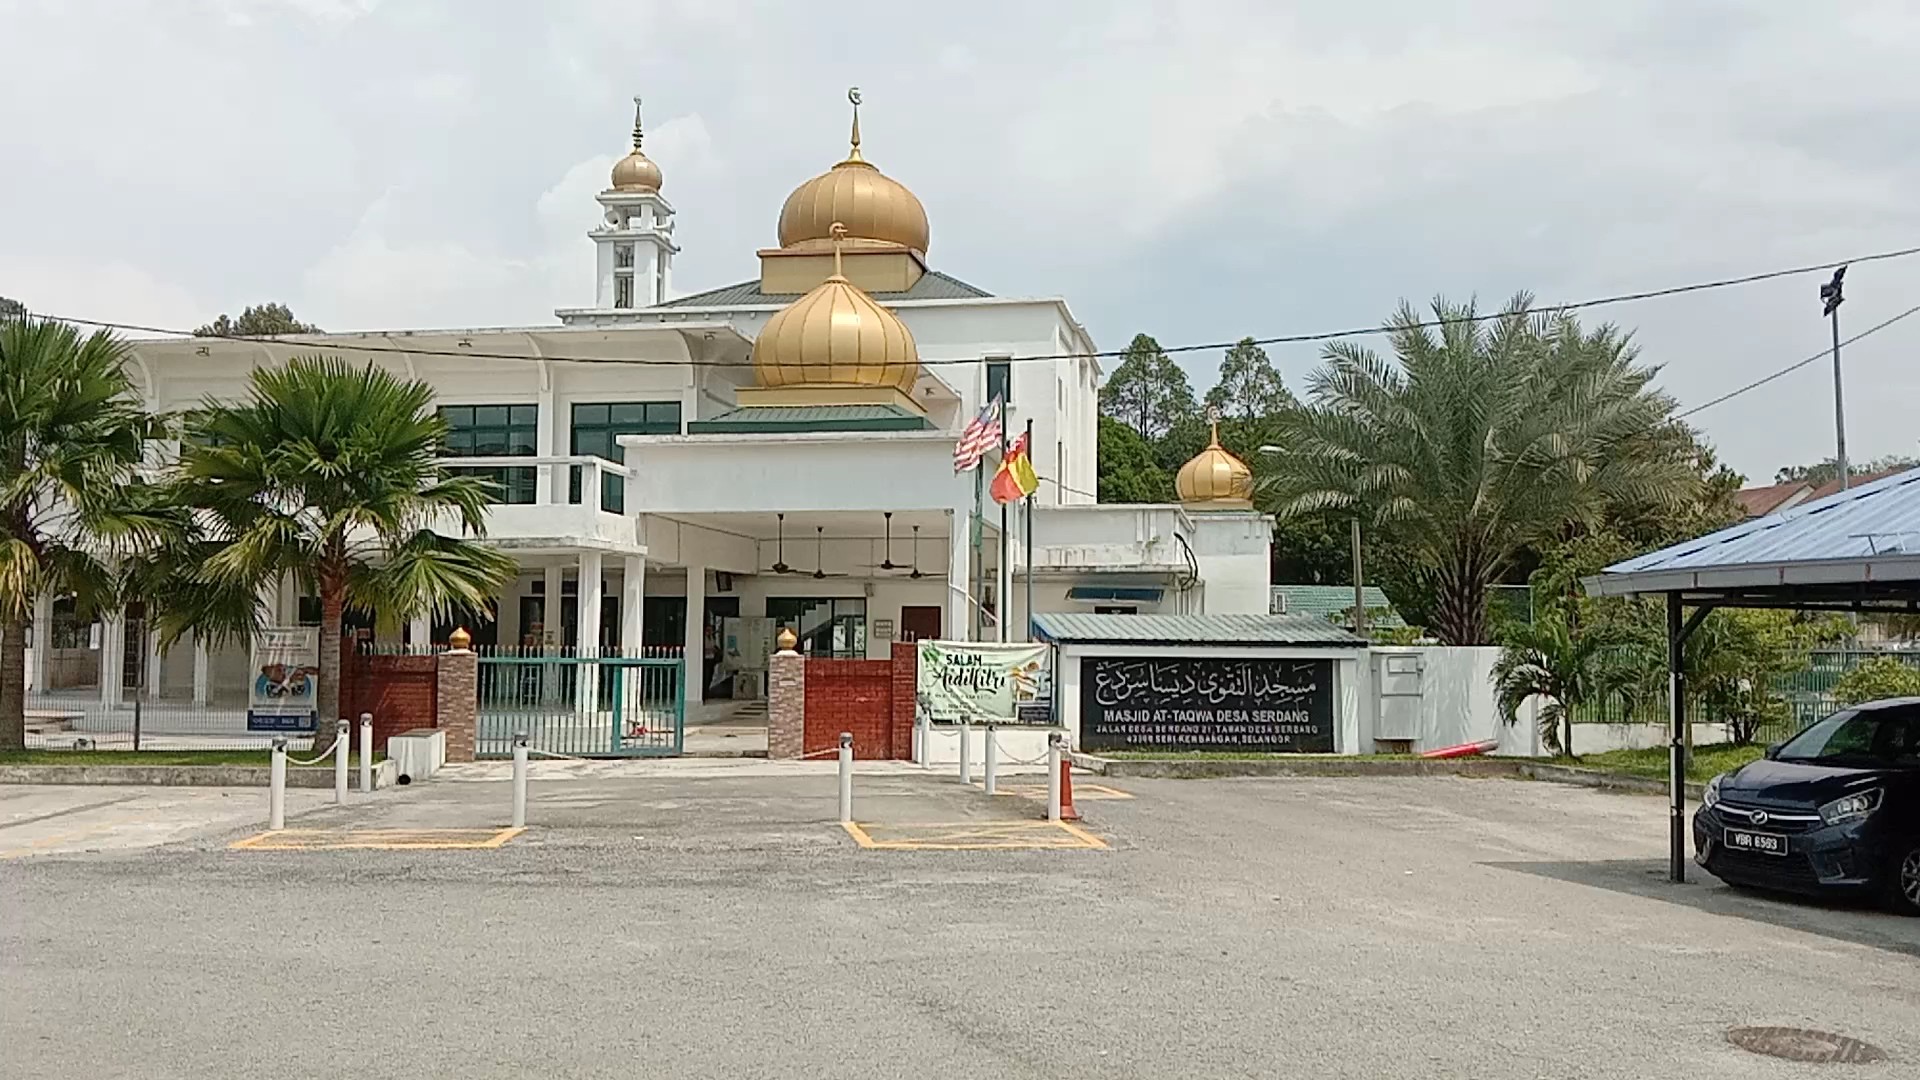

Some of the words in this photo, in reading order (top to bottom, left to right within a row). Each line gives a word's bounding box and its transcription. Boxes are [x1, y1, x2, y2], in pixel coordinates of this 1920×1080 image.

[945, 654, 982, 667] SALAM
[1103, 709, 1151, 722] MASJID
[1153, 709, 1214, 722] AT-TAQWA
[1216, 709, 1249, 722] DESA
[1251, 709, 1309, 722] SERDANG
[1096, 724, 1126, 734] JALAN
[1247, 724, 1272, 734] DESA
[1274, 724, 1318, 734] SERDANG
[1734, 832, 1752, 847] VBR
